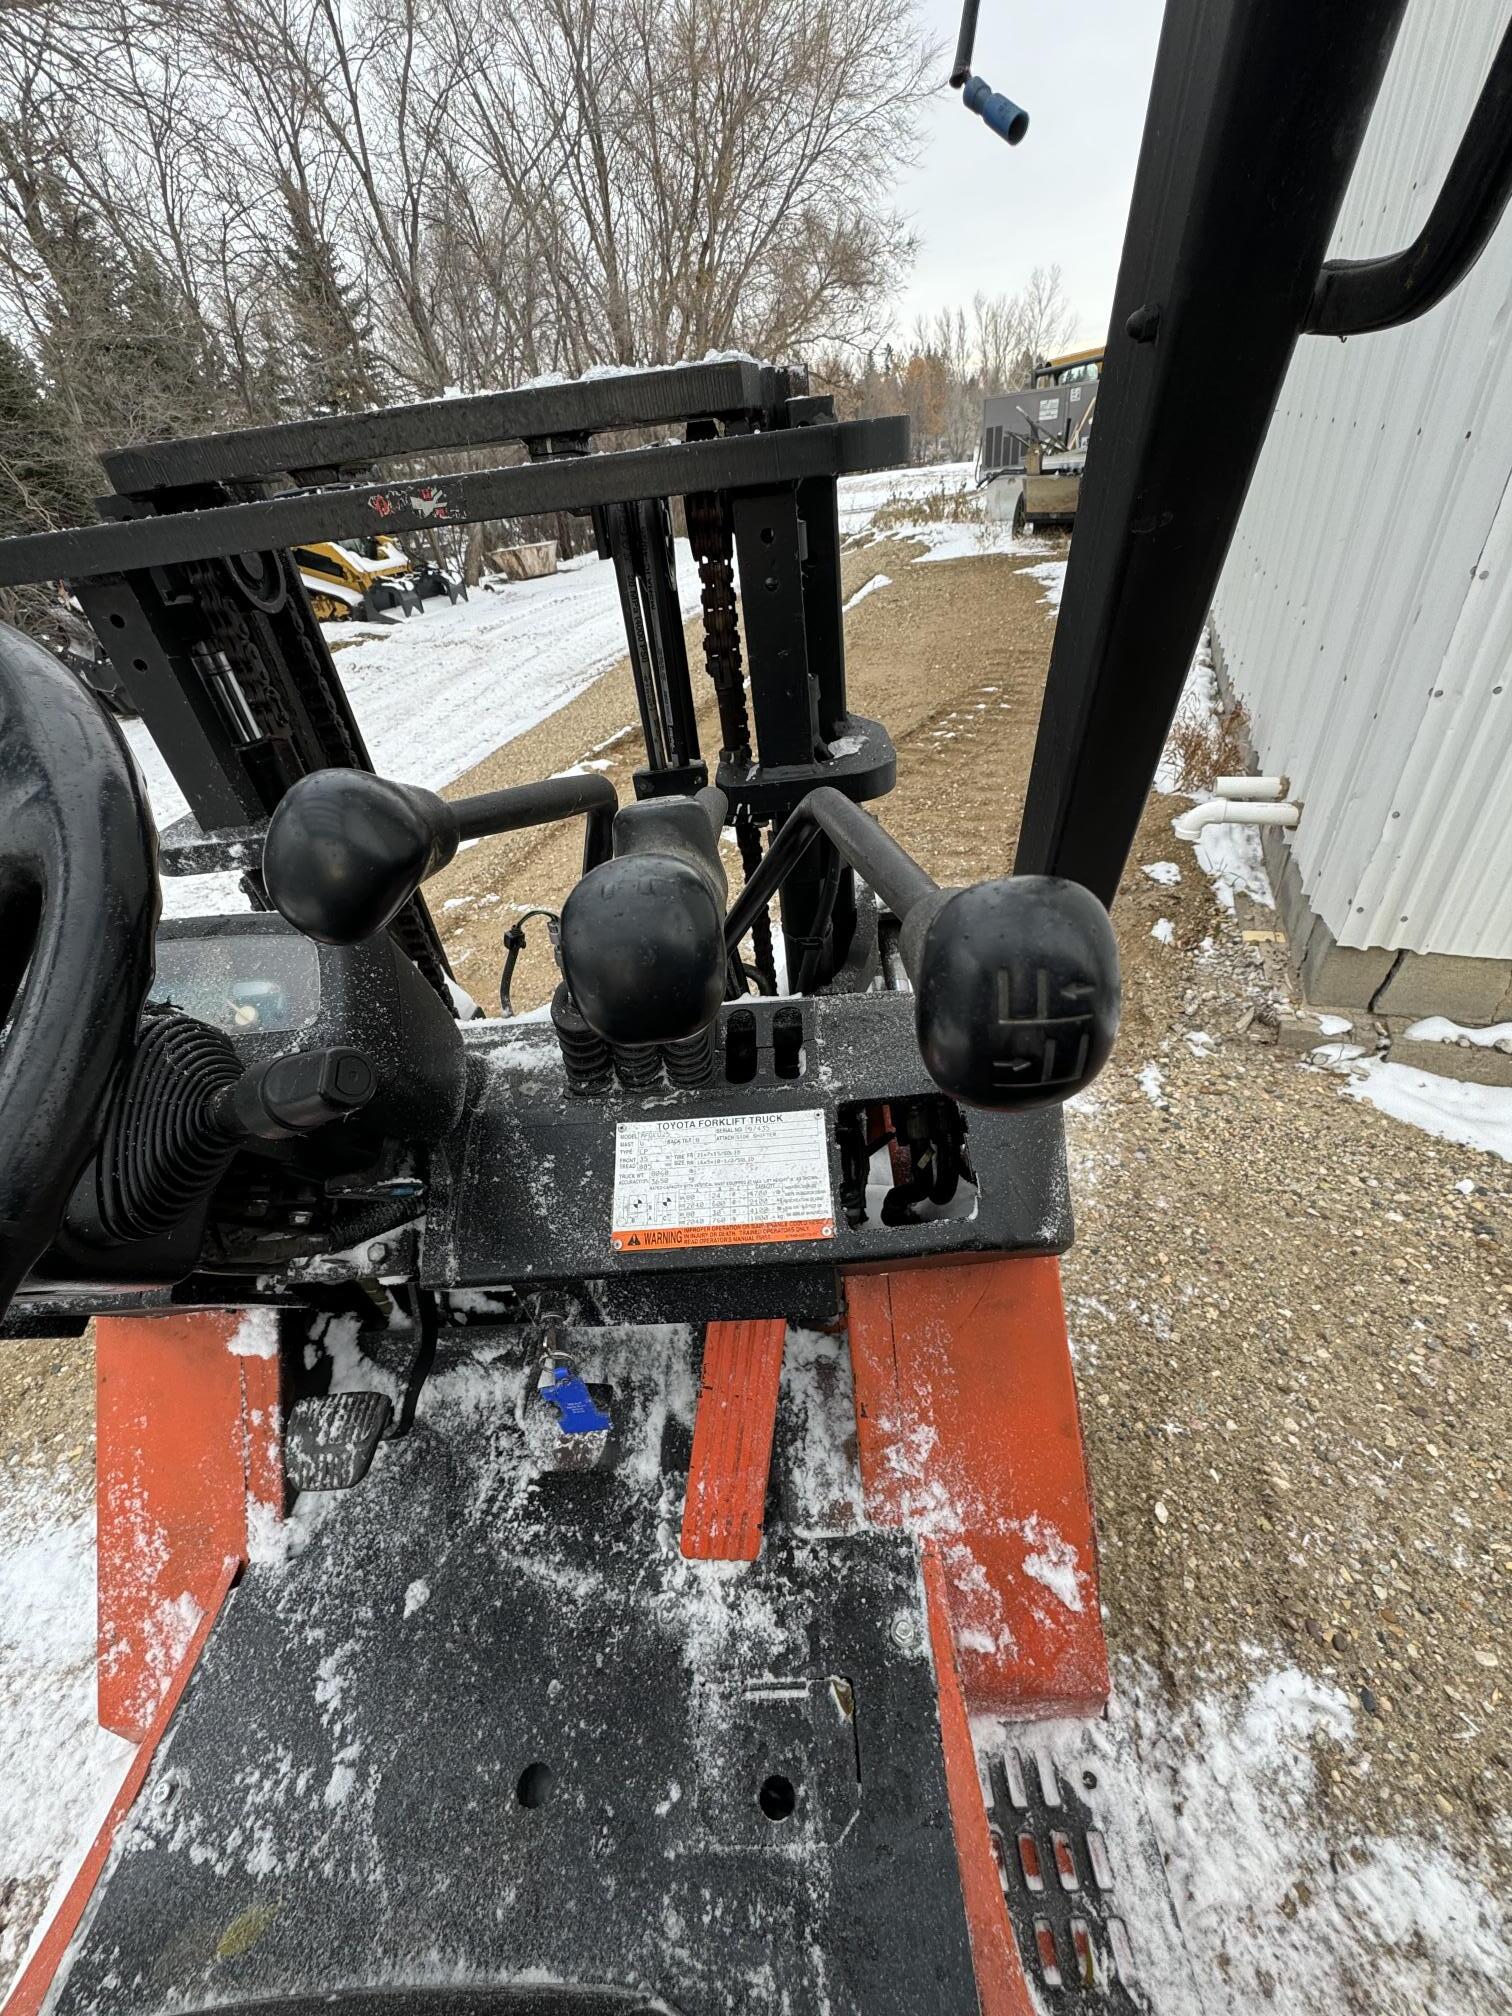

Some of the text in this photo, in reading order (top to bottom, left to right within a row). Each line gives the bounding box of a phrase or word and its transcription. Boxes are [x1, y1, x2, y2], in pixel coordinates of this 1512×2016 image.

[657, 1114, 783, 1130] TOYOTA FORKLIFT TRUCK
[644, 1230, 682, 1245] WARNING
